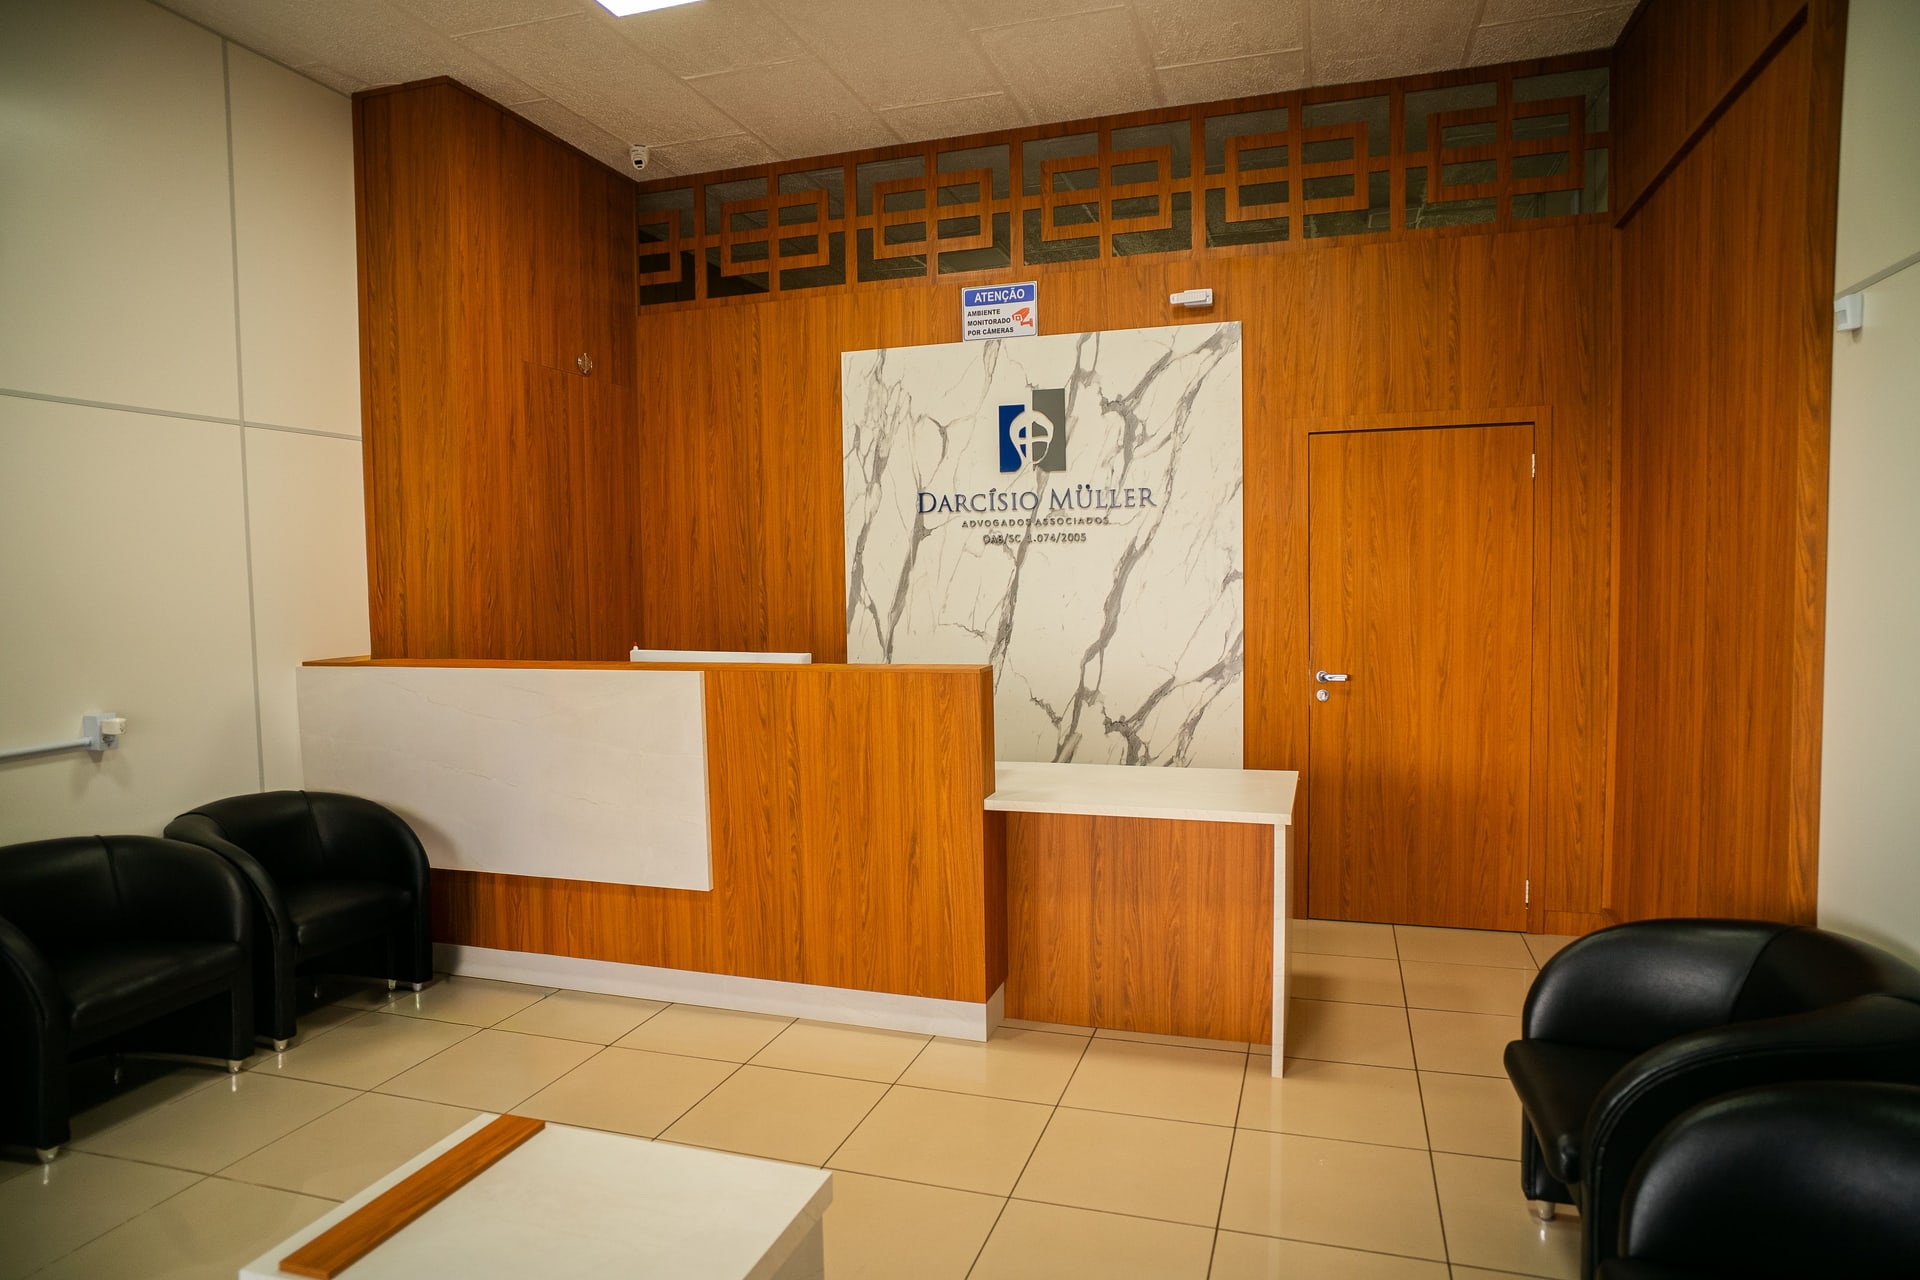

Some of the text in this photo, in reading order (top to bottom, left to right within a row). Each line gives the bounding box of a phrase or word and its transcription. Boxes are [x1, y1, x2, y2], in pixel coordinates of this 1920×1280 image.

[974, 288, 1025, 302] ATENÇÃO
[967, 309, 1001, 317] AMBIENTE
[967, 318, 1011, 326] MONITORADO
[982, 327, 1014, 335] CÂMERAS
[917, 484, 1157, 514] DARCÍSIO MÜLLER
[961, 517, 1109, 528] ADVOGADOS ASSOCIADOS
[983, 534, 1021, 545] OAB/SC
